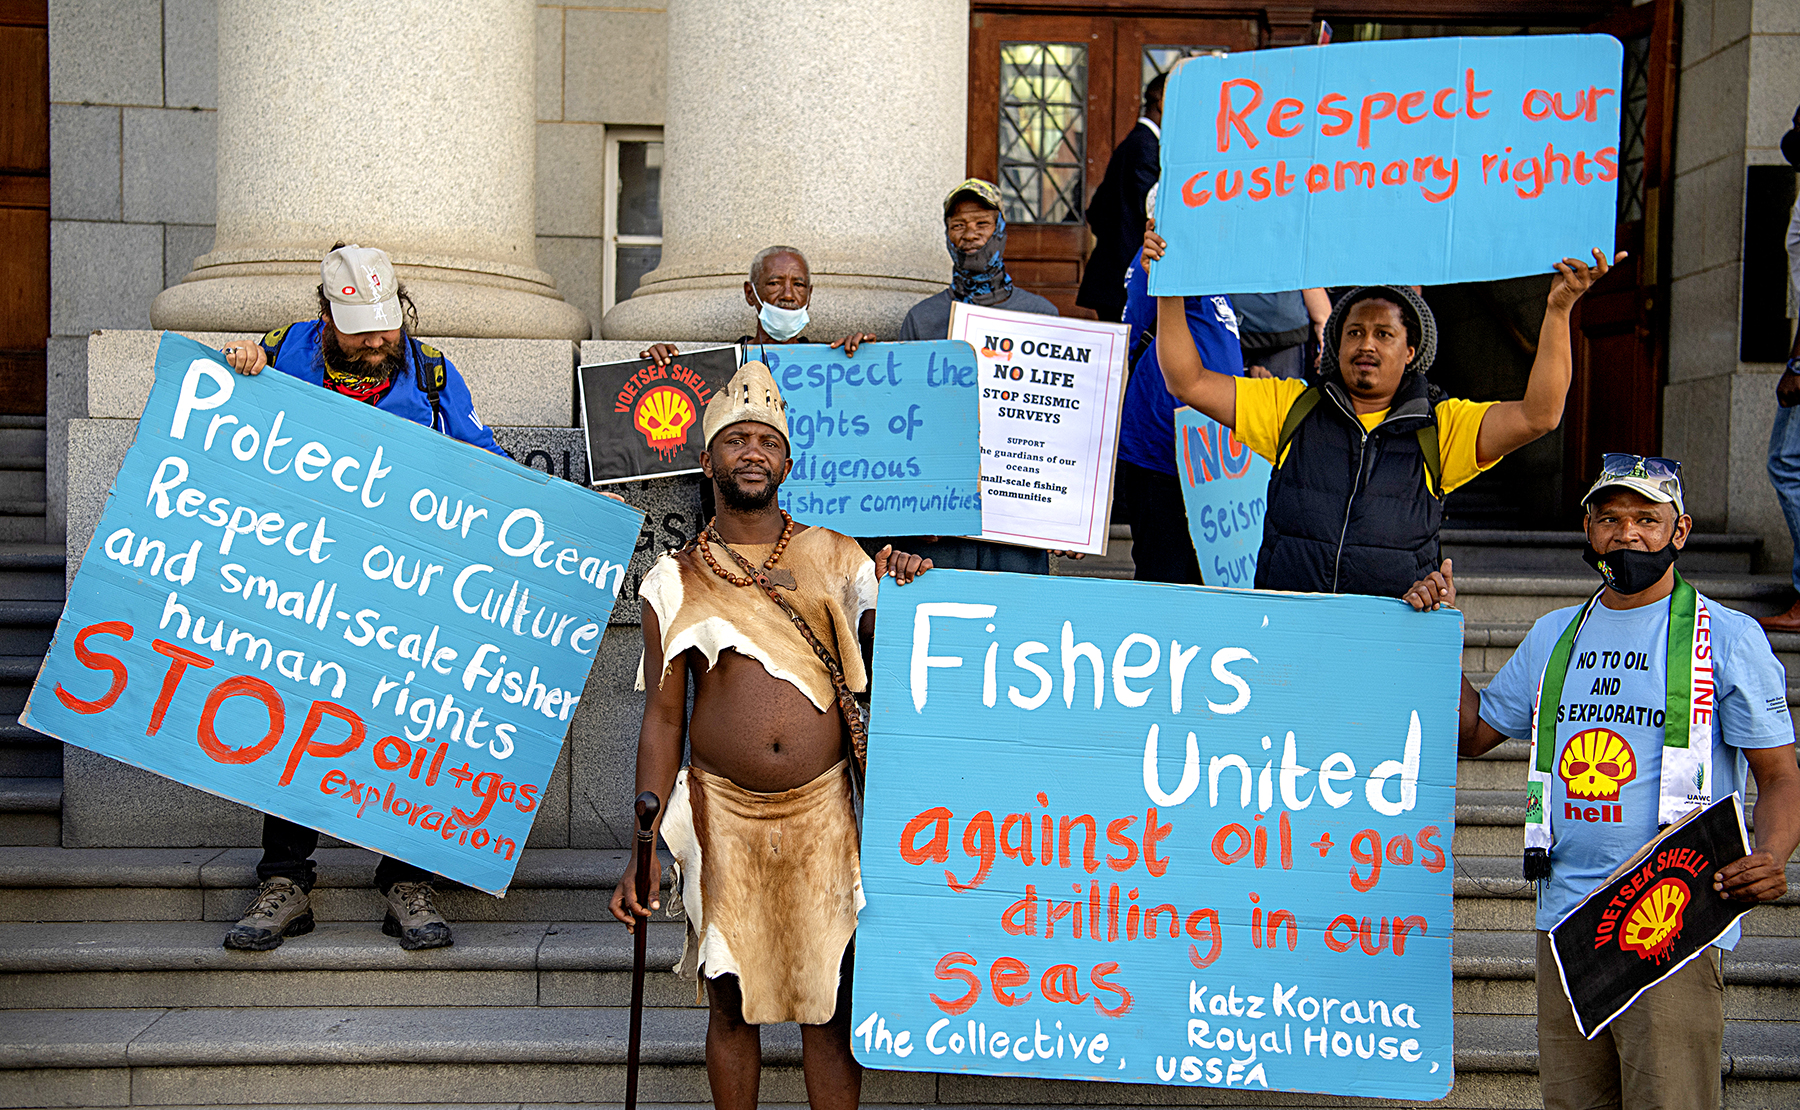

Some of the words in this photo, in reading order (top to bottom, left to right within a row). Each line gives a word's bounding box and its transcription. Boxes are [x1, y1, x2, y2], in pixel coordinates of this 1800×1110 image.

[1216, 68, 1493, 153] Respect
[1522, 85, 1615, 123] our
[1181, 153, 1460, 209] customary
[1482, 142, 1619, 201] rights
[927, 350, 978, 388] the
[985, 335, 1013, 352] NO
[1021, 340, 1090, 362] OCEAN
[614, 364, 669, 413] VOETSEK
[983, 387, 1018, 402] STOP
[1022, 393, 1080, 410] SEISMIC
[993, 364, 1023, 380] NO
[1029, 368, 1074, 388] LIFE
[788, 407, 870, 450] ights
[888, 404, 923, 441] of
[998, 406, 1060, 424] SURVEYS
[980, 446, 992, 455] he
[993, 449, 1044, 462] guardians
[1058, 458, 1076, 466] our
[1006, 437, 1045, 448] SUPPORT
[1182, 420, 1252, 488] NO
[169, 358, 393, 508] Protect
[409, 488, 489, 539] our
[498, 508, 626, 599] Ocean
[791, 451, 922, 487] digenous
[980, 475, 1031, 488] mall-scale
[1033, 480, 1067, 494] fishing
[1005, 463, 1040, 474] oceans
[778, 488, 851, 516] isher
[860, 485, 983, 513] communities
[987, 488, 1051, 503] communities
[1200, 497, 1266, 544] Seism
[104, 527, 203, 587] and
[147, 456, 337, 563] Respect
[362, 545, 444, 597] our
[452, 564, 600, 656] Culture
[159, 591, 347, 699] human
[371, 670, 518, 760] rights
[1576, 651, 1598, 670] NO
[1602, 651, 1622, 670] TO
[1624, 652, 1650, 671] OIL
[1692, 597, 1714, 727] ALESTINE
[54, 620, 369, 787] STOP
[1590, 677, 1622, 696] AND
[1568, 704, 1666, 729] EXPLORATIO
[1143, 709, 1423, 816] United
[319, 769, 517, 862] exploration
[1564, 802, 1623, 823] hell
[900, 791, 1173, 893] against
[1211, 809, 1294, 870] oil
[1349, 824, 1447, 893] gas
[1594, 861, 1656, 950] VOETSEK
[1656, 847, 1709, 879] SHELL!
[1000, 880, 1222, 968] drilling
[1249, 892, 1298, 951] in
[1323, 913, 1427, 957] our
[1189, 979, 1267, 1020] Katz
[1272, 981, 1422, 1029] Korana
[854, 1011, 914, 1058] The
[1187, 1018, 1292, 1065] Royal
[1155, 1055, 1269, 1089] USSFA
